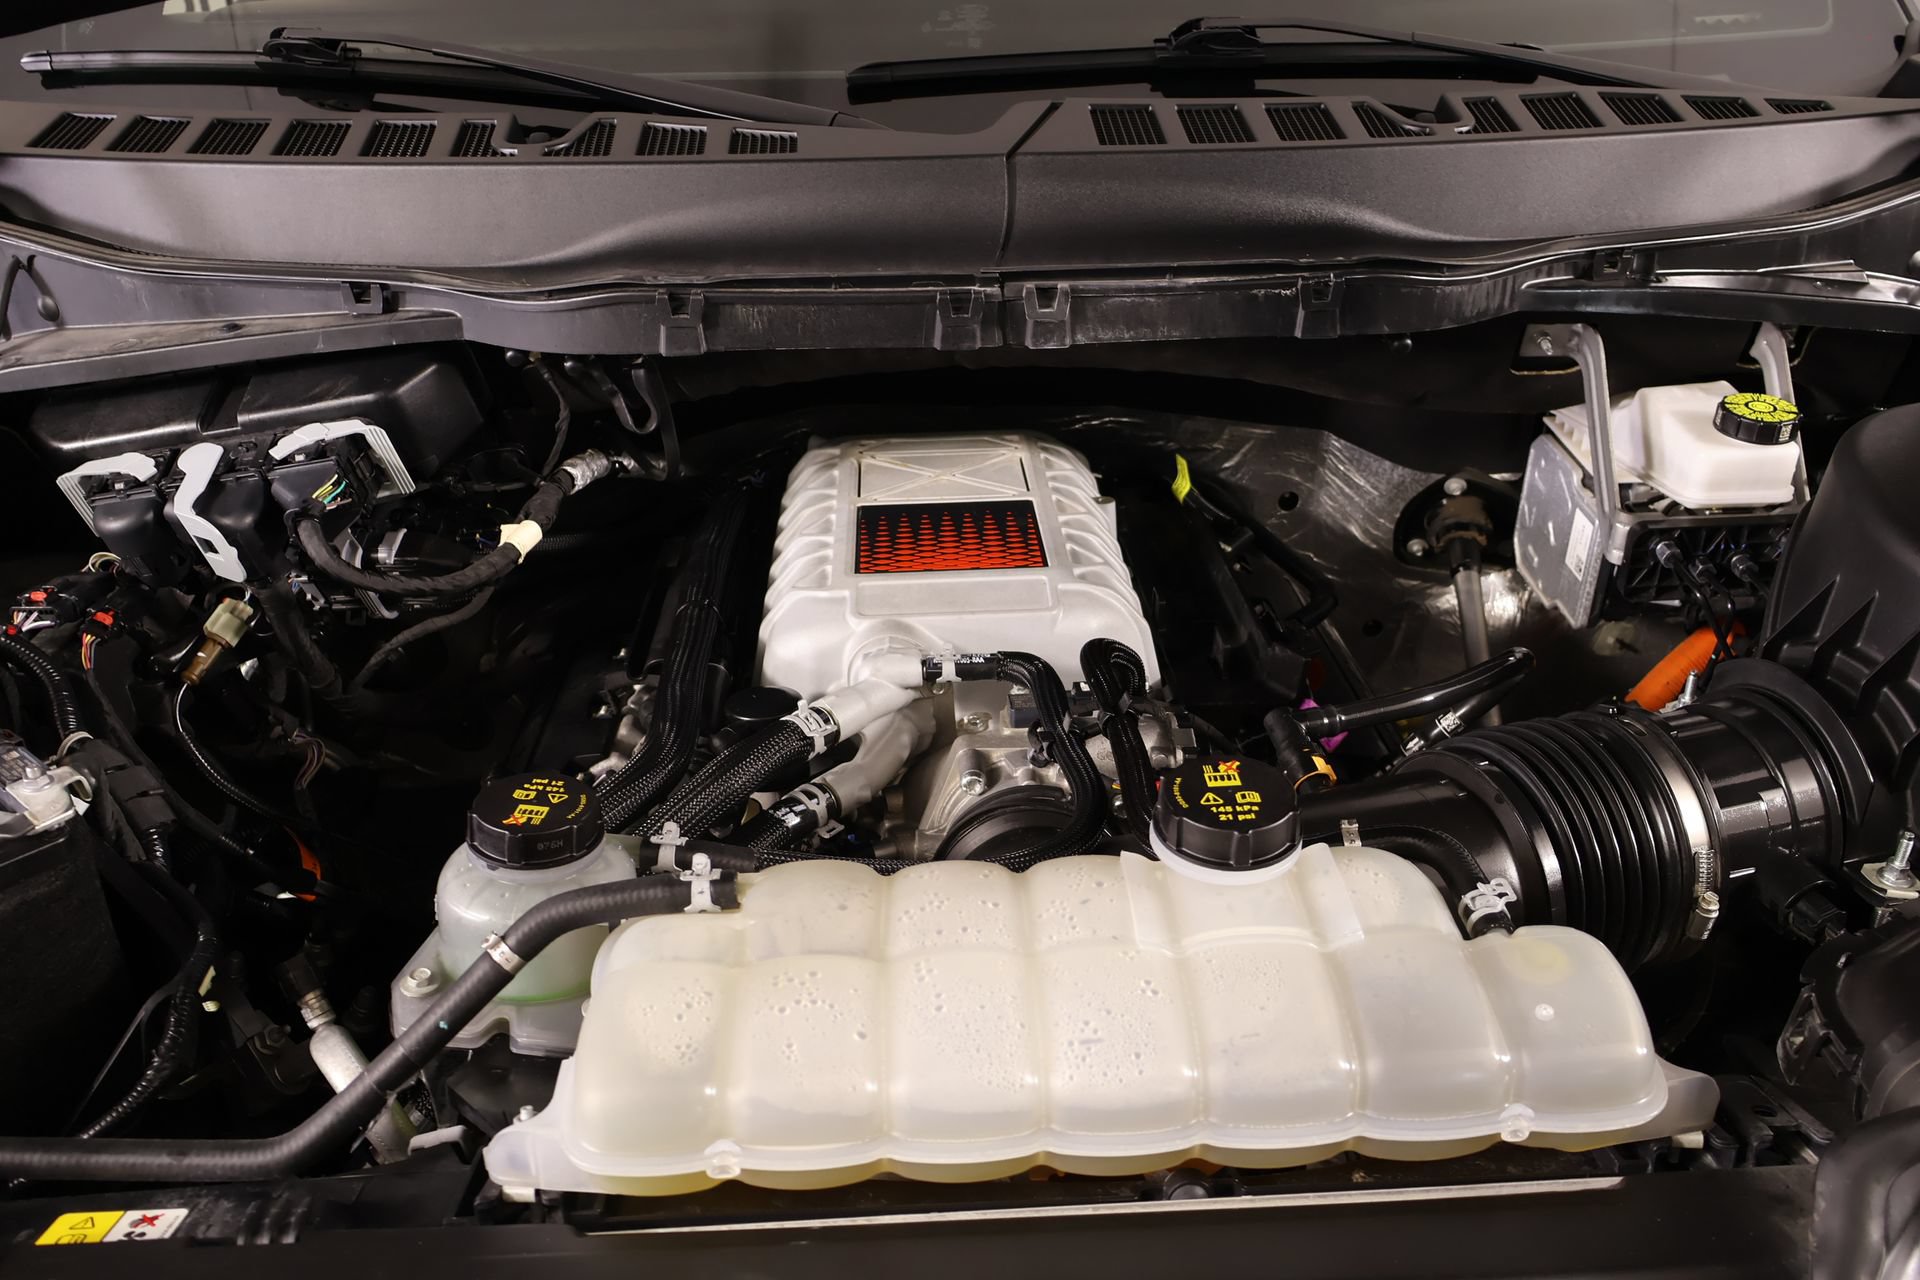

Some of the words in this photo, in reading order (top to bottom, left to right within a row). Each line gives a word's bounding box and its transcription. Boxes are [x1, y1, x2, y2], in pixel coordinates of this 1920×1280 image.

[1210, 805, 1233, 813] 145
[1218, 813, 1234, 821] 21
[1237, 813, 1256, 821] psi
